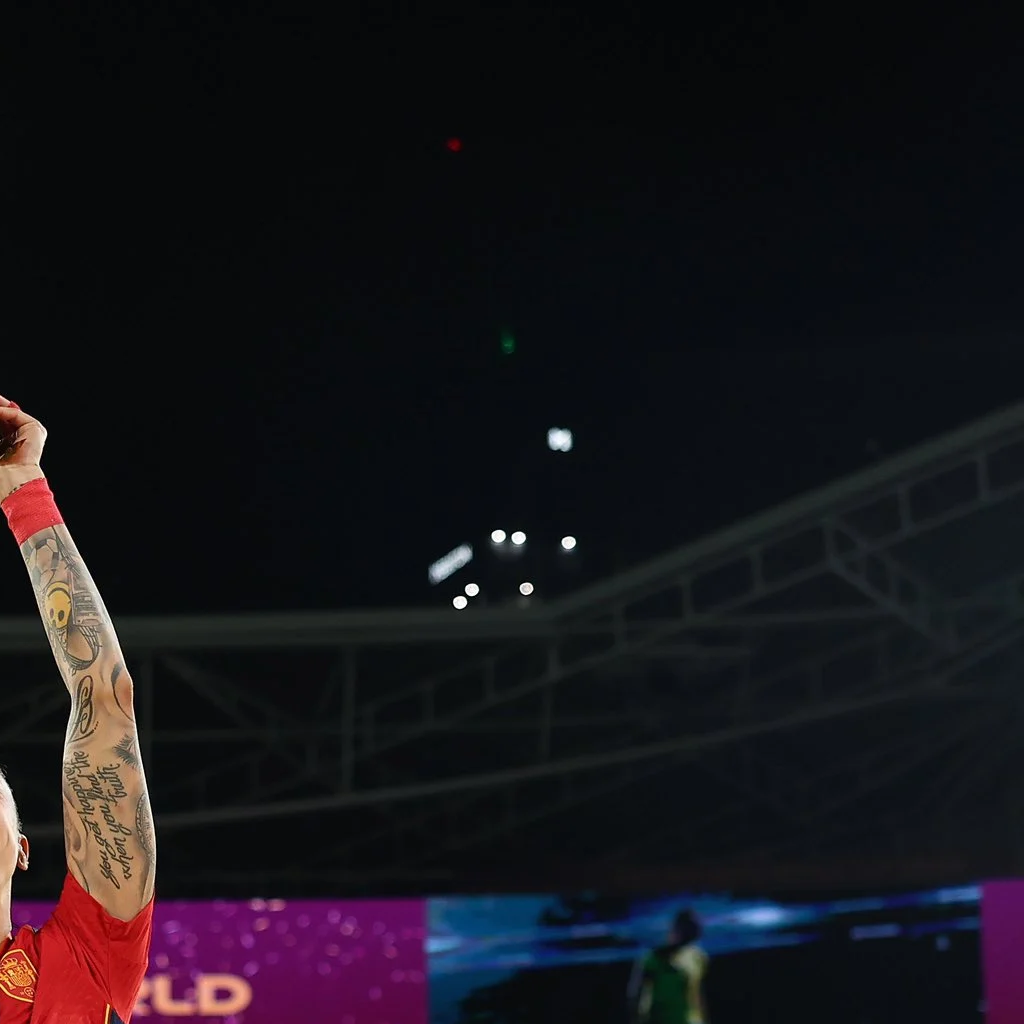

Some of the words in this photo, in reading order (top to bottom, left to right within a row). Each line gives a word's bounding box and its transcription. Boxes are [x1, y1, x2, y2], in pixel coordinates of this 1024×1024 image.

[77, 773, 117, 807] find
[99, 803, 133, 837] you
[99, 849, 121, 890] you
[114, 837, 134, 880] when
